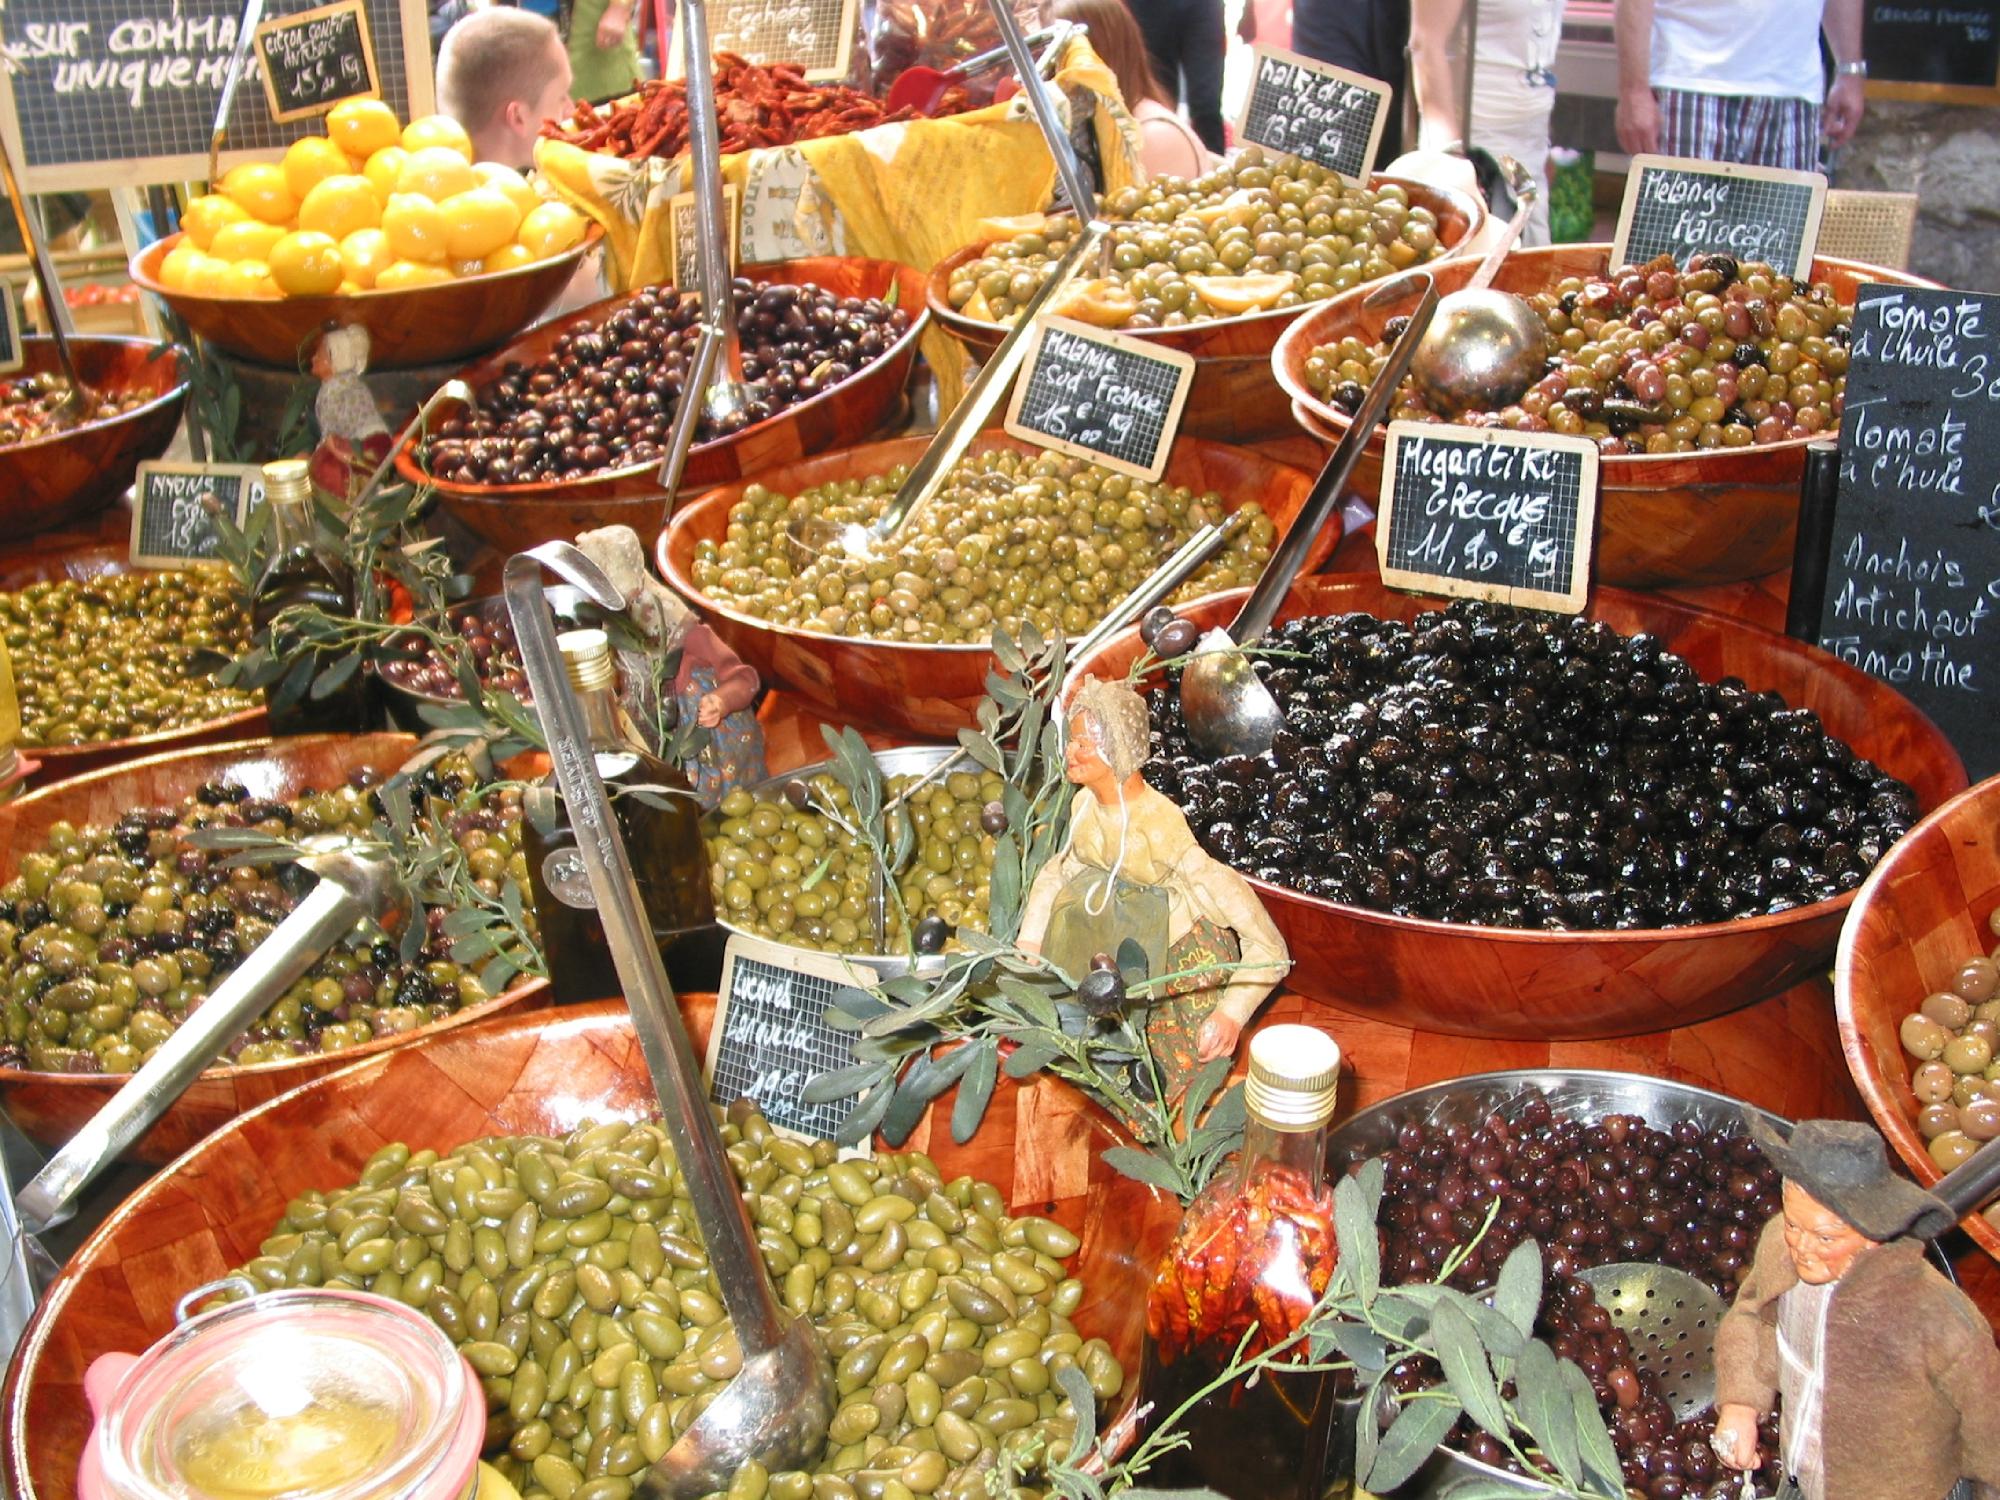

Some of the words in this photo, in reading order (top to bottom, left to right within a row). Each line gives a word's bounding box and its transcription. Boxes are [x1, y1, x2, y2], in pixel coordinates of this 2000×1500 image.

[1858, 294, 1987, 338] Tomate
[1845, 398, 1966, 454] Tomate
[1843, 532, 1965, 587] Anchois
[1834, 578, 1989, 639] Artichaut
